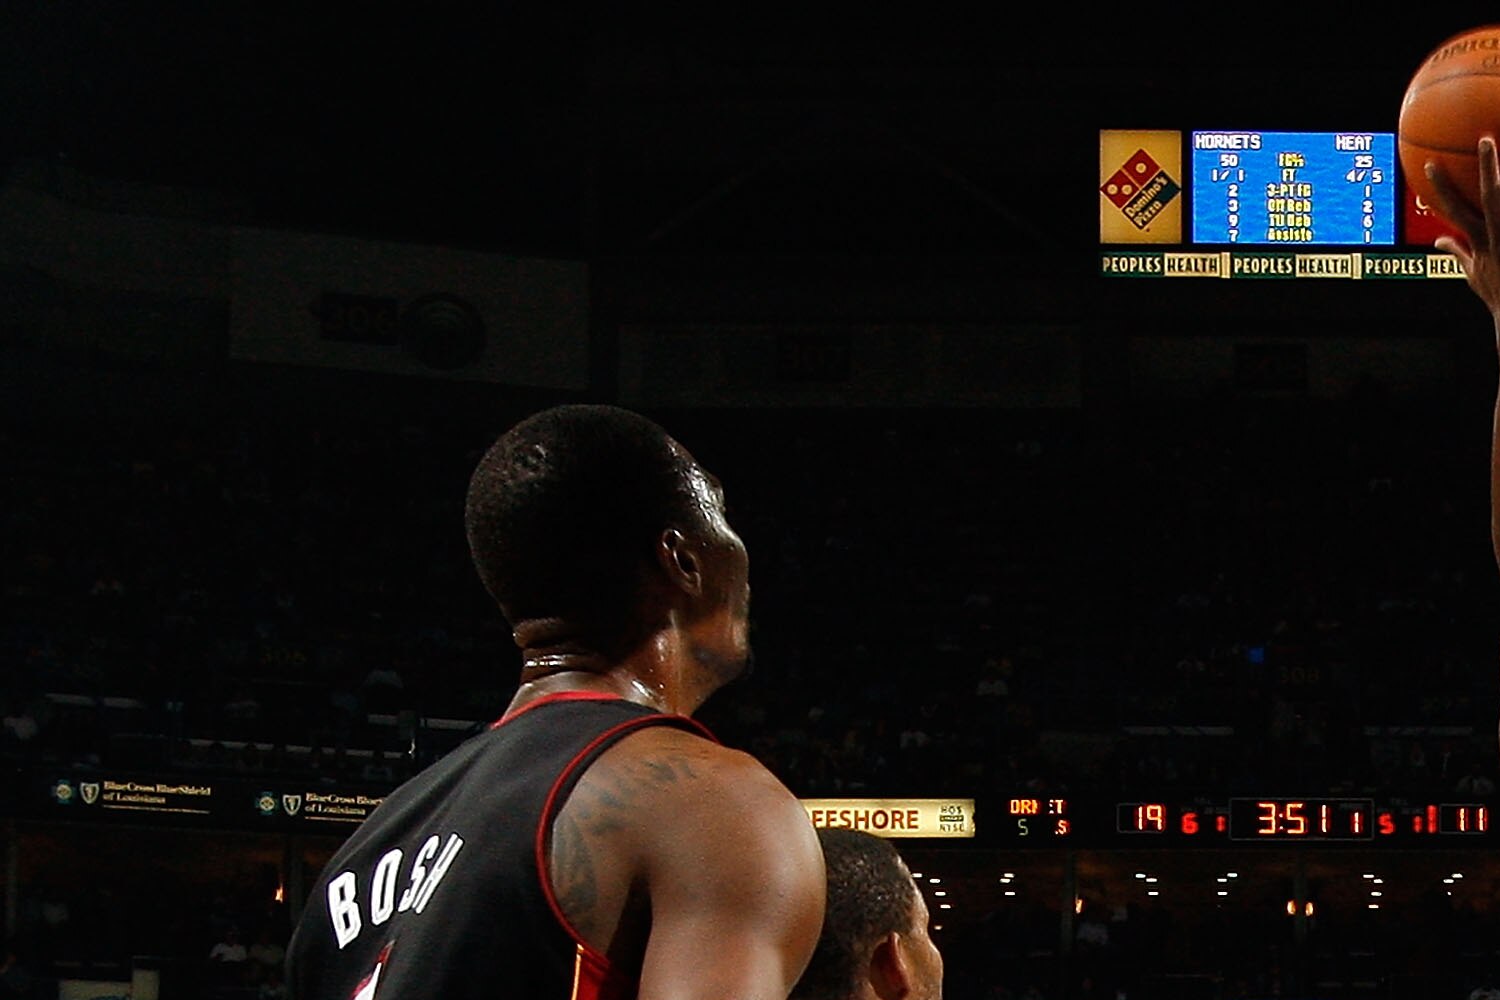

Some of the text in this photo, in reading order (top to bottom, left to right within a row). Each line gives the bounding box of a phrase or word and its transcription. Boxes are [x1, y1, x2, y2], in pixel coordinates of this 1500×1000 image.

[1195, 134, 1373, 150] HORNETS HEAT
[1220, 154, 1238, 167] 50
[1354, 155, 1373, 168] 25
[1282, 169, 1296, 182] FT
[1228, 184, 1238, 197] 2
[1365, 185, 1371, 198] 1
[1228, 199, 1238, 212] 3
[1363, 200, 1373, 213] 2
[1228, 214, 1239, 227] 9
[1363, 216, 1373, 228] 6
[1228, 229, 1239, 242] 7
[1365, 230, 1371, 243] 1
[1102, 256, 1218, 273] PEOPLES HEALTH
[1233, 257, 1349, 274] PEOPLES HEALTH
[1365, 258, 1423, 275] PEOPLES
[1136, 804, 1164, 832] 19
[328, 833, 464, 949] BOSH
